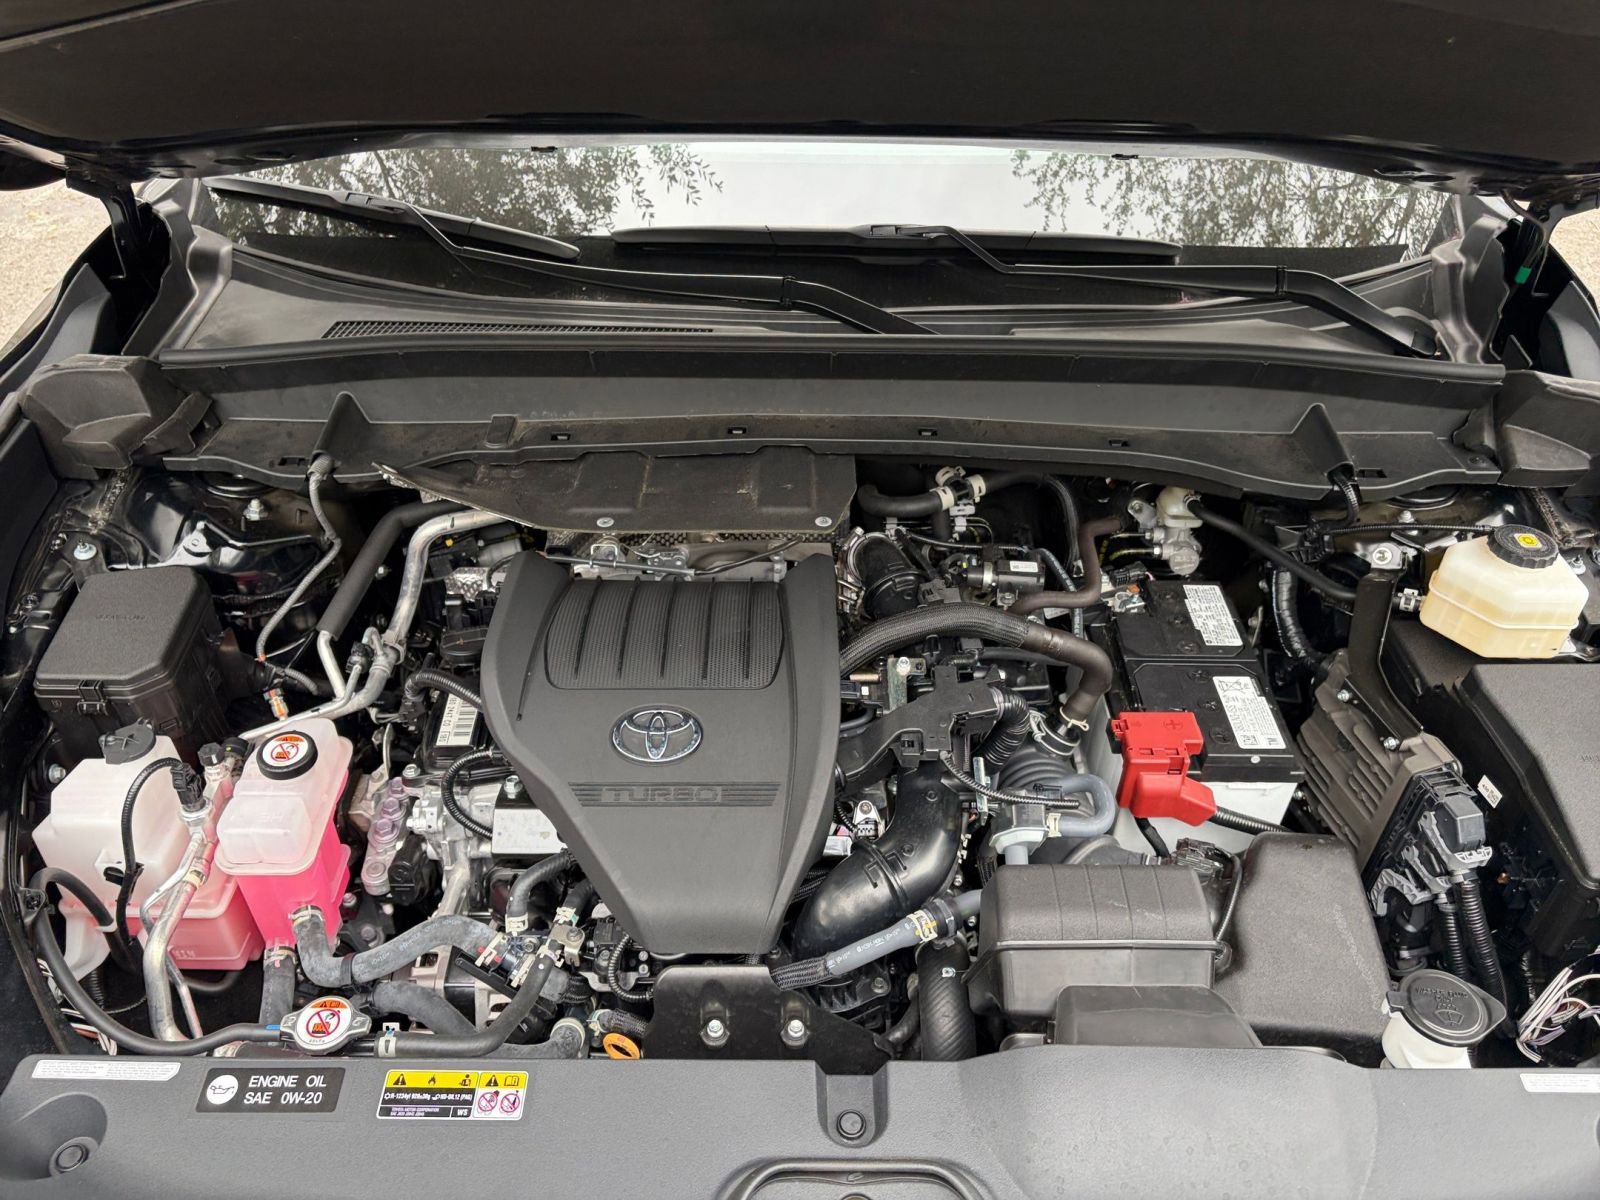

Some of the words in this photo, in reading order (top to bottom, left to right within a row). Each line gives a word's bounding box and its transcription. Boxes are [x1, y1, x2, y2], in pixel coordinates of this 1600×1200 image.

[604, 786, 719, 802] TURBO
[248, 1075, 299, 1088] ENGINE
[305, 1075, 327, 1088] OIL
[243, 1091, 273, 1105] SAE
[280, 1091, 323, 1105] 0W-20
